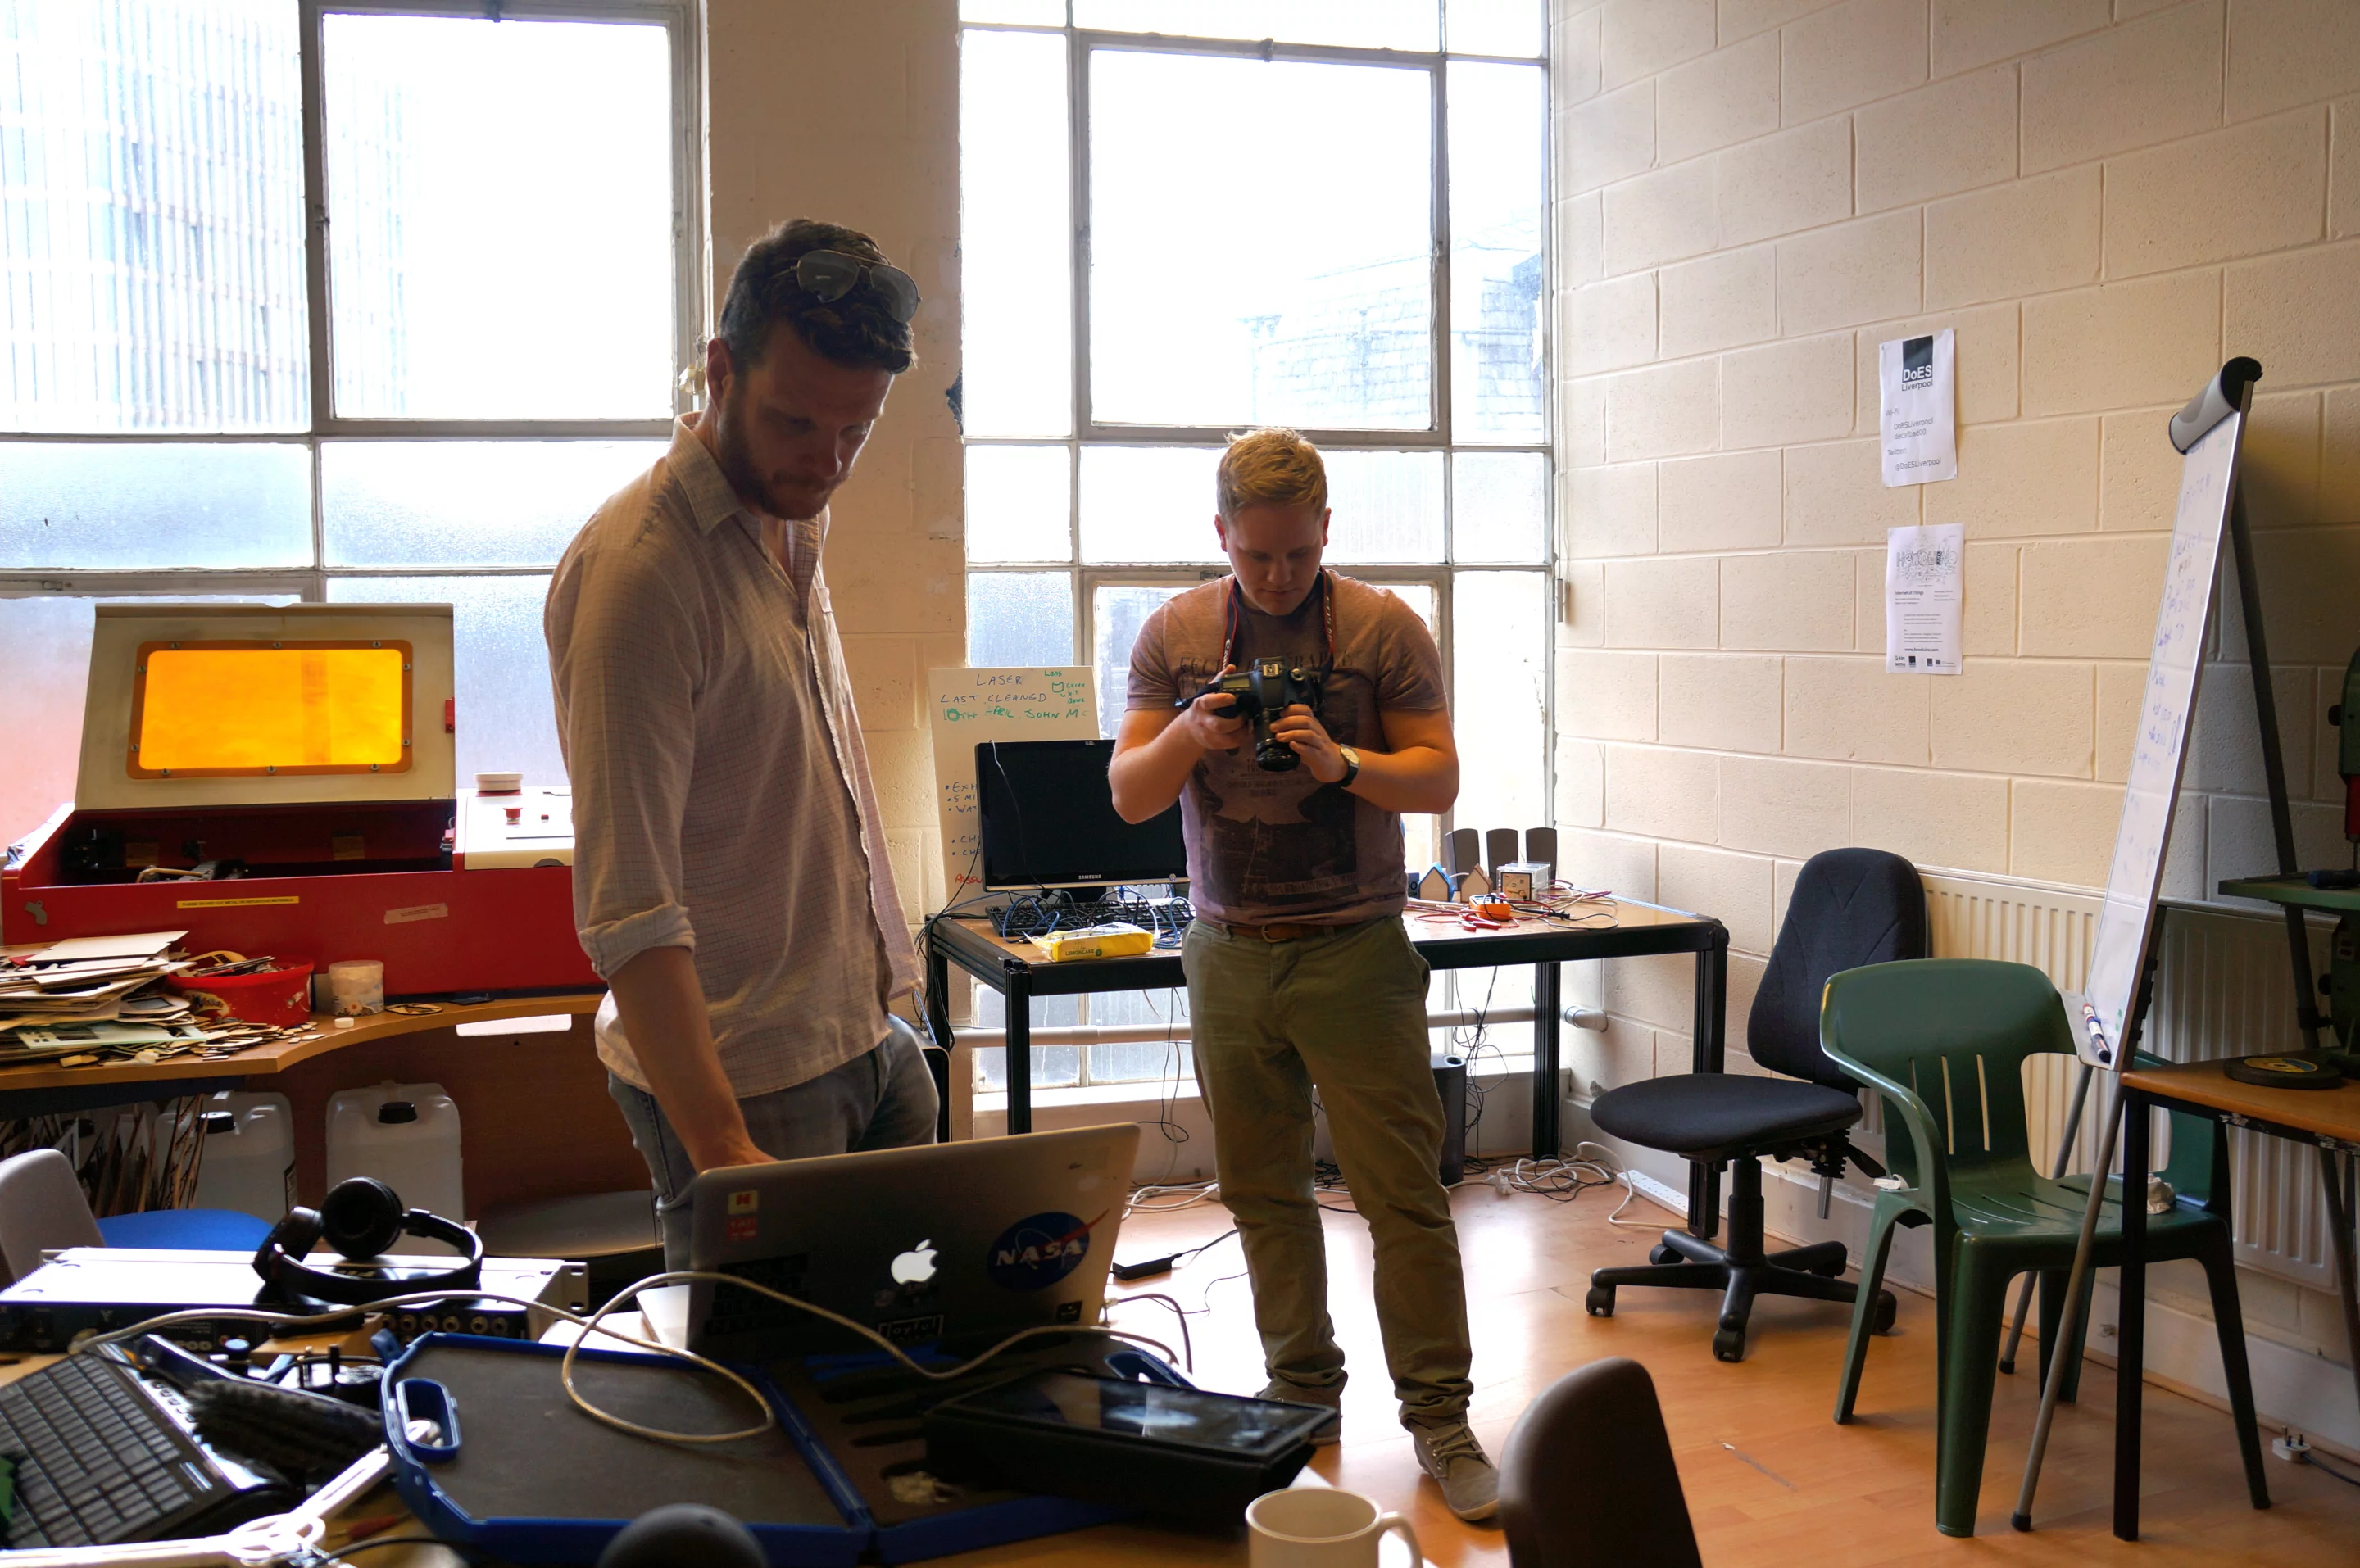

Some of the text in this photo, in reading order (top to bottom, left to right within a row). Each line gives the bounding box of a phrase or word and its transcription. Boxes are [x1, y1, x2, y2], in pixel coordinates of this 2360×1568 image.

[1903, 365, 1932, 382] DoES
[1901, 379, 1933, 392] Liverpool
[1894, 417, 1934, 430] DoESLiverpool
[1895, 457, 1941, 471] @DoESLiverpool
[976, 673, 1023, 687] LASER
[941, 693, 1047, 703] LAST CLEANED
[1024, 709, 1060, 719] JOHN
[995, 1239, 1082, 1268] NASA
